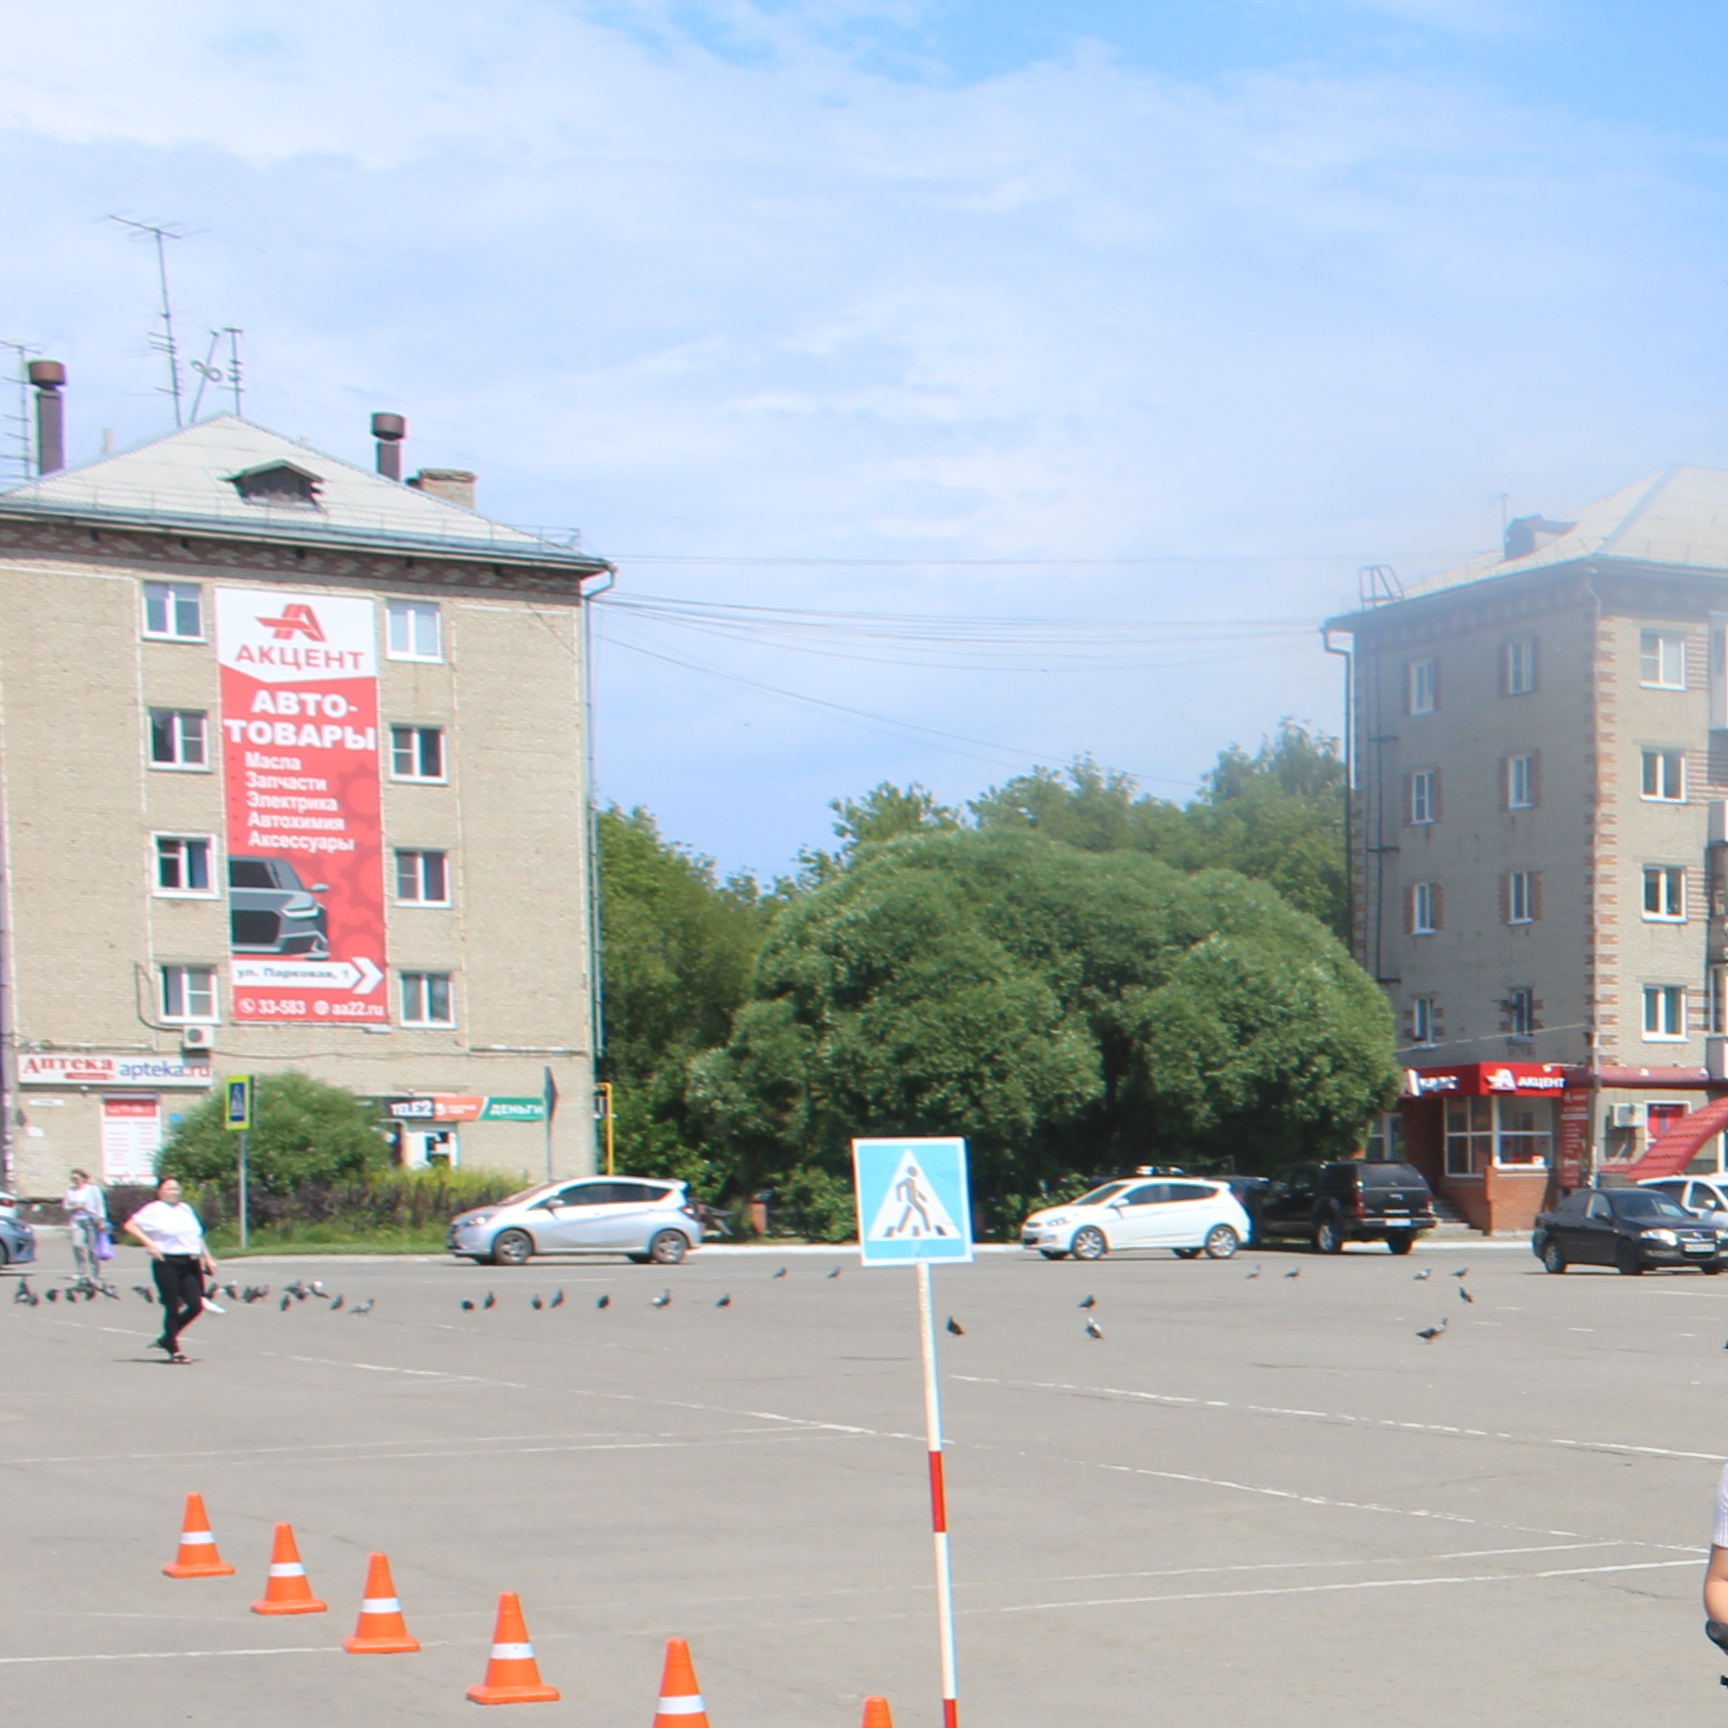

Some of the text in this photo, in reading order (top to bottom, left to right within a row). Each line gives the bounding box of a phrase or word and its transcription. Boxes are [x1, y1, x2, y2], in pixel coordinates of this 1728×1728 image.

[235, 644, 365, 671] АКЦЕНТ
[251, 690, 358, 718] АВТО-
[223, 718, 377, 750] ТОВАРЫ
[244, 751, 302, 771] Масла
[245, 771, 328, 791] Запчасти
[246, 791, 339, 813] Электрика
[247, 811, 346, 831] Автохимия
[248, 830, 355, 853] Аксессуары
[257, 998, 306, 1015] 33-583
[23, 1058, 114, 1074] Аптека
[119, 1060, 210, 1079] apteka.ru
[1517, 1076, 1566, 1090] АКЦЕНТ
[391, 1101, 433, 1116] TELE2
[489, 1103, 546, 1115] ДЕНЬГИ
